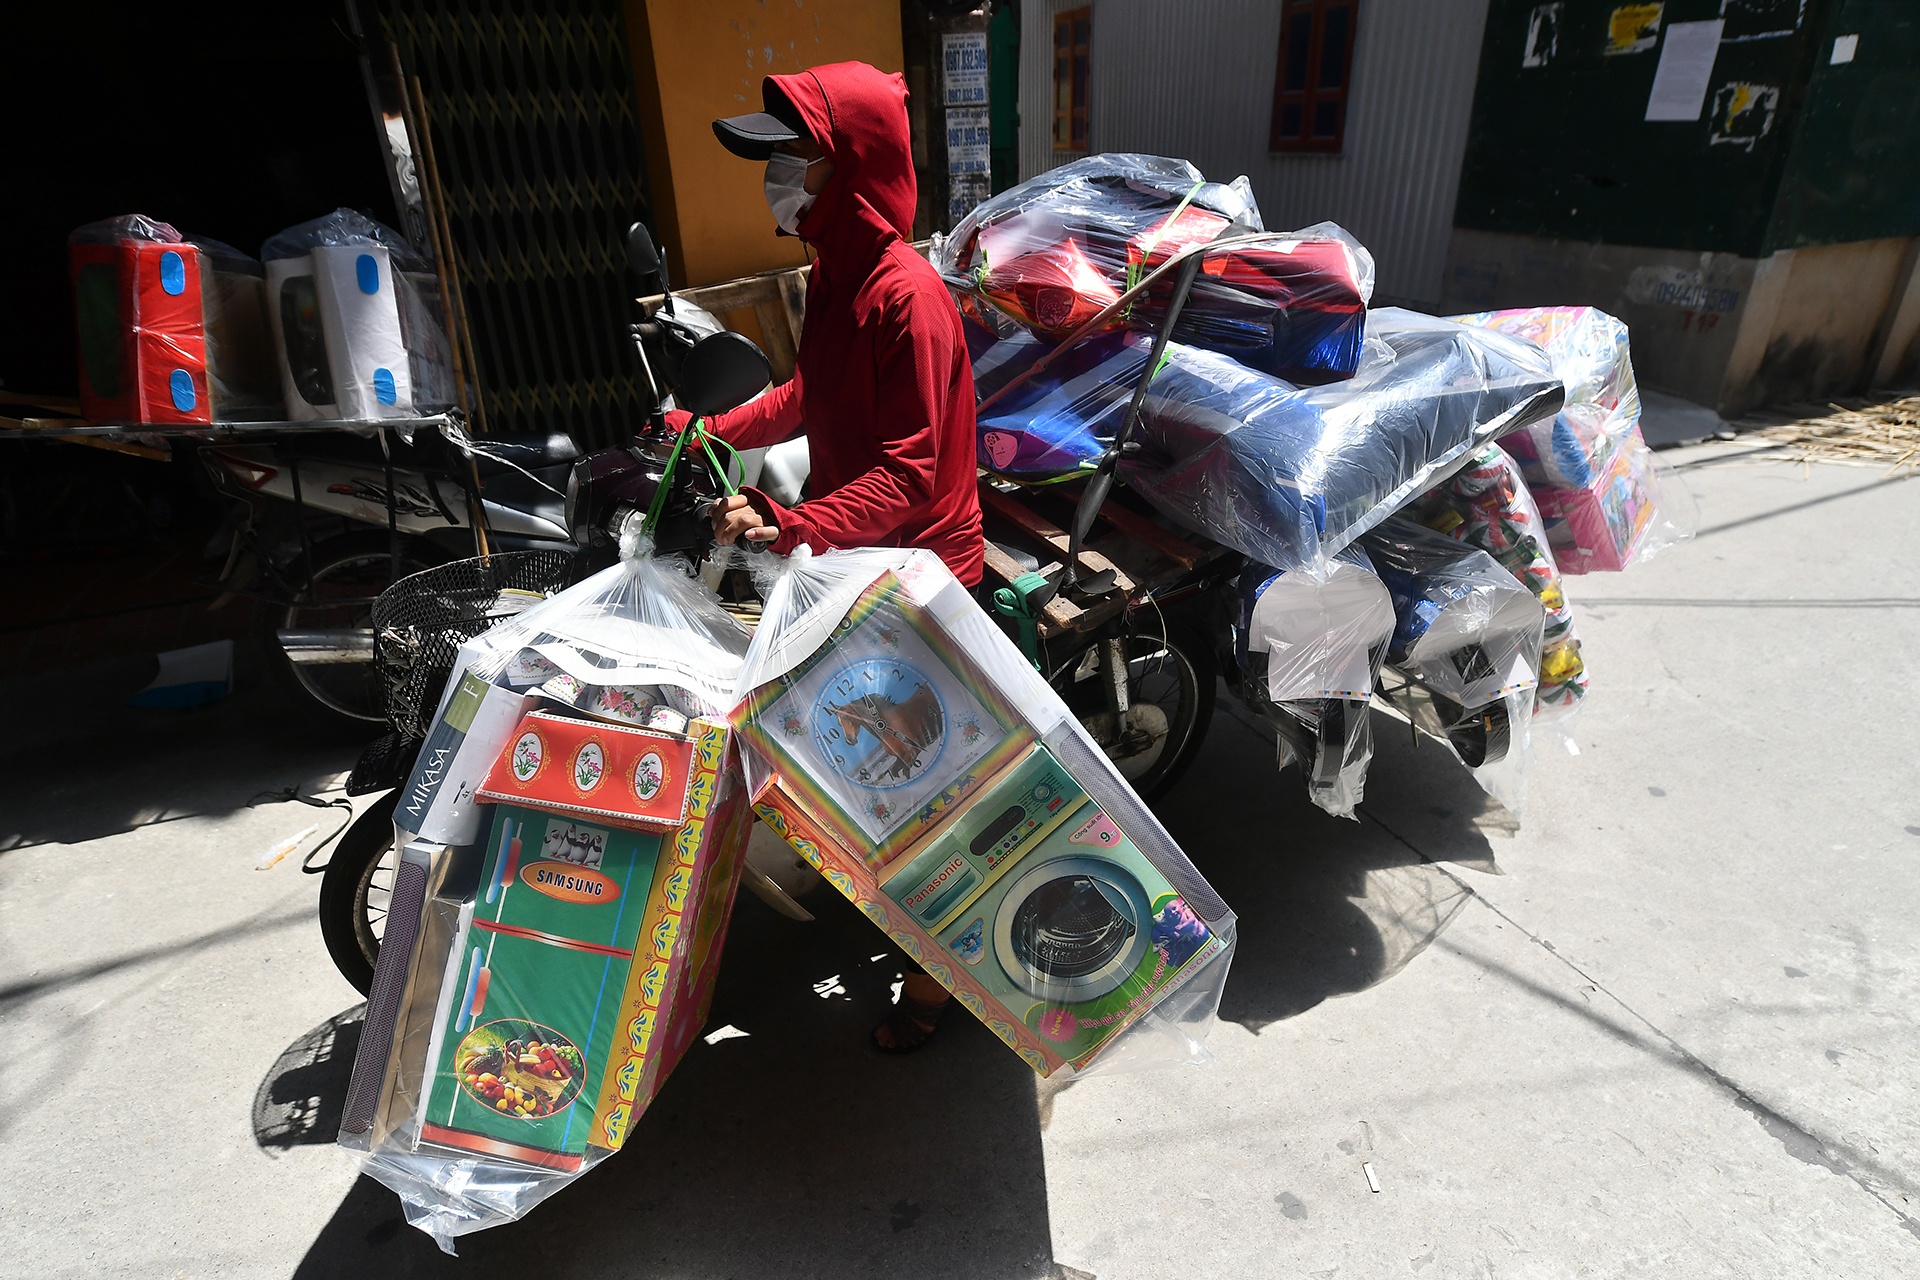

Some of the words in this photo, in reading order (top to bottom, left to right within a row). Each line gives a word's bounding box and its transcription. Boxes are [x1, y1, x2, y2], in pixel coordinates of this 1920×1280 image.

[862, 670, 874, 682] 1
[892, 668, 904, 682] 2
[837, 678, 855, 697] 12
[823, 727, 841, 746] 10
[834, 754, 846, 767] 9
[859, 768, 872, 780] 8
[537, 869, 604, 897] SAMSUNG
[906, 858, 964, 909] Panasonic
[1160, 941, 1221, 995] Panasonic
[1050, 1013, 1063, 1036] New
